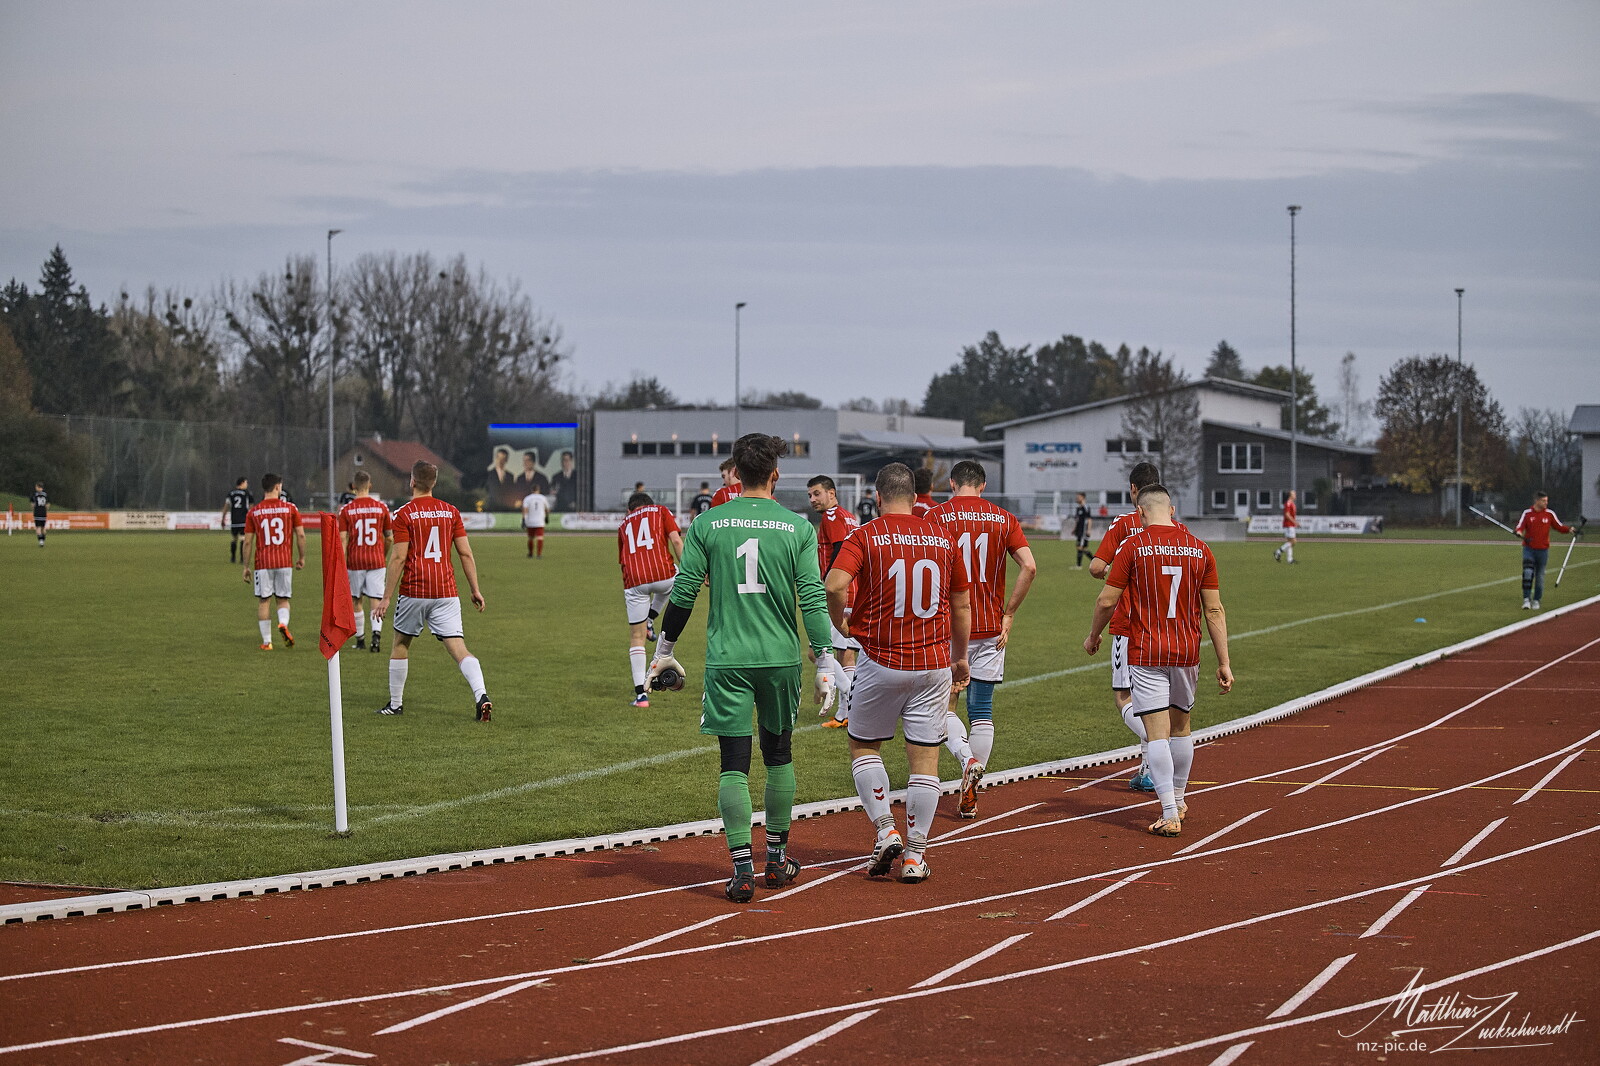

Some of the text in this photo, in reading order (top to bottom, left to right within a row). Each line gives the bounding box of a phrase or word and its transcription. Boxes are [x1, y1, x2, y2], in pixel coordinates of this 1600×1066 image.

[234, 496, 242, 508] 2
[409, 510, 453, 520] TUS ENGELSBERG
[260, 517, 285, 546] 13
[711, 518, 795, 533] TUS ENGELSBERG
[940, 511, 1006, 524] TUS ENGELSBERG
[355, 518, 378, 546] 15
[424, 526, 443, 563] 4
[625, 517, 655, 554] 14
[871, 533, 951, 550] TUS ENGELSBERG
[736, 538, 767, 594] 1
[957, 532, 989, 583] 11
[1137, 545, 1203, 559] TUS ENGELSBERG
[888, 558, 941, 619] 10
[1161, 565, 1183, 619] 7
